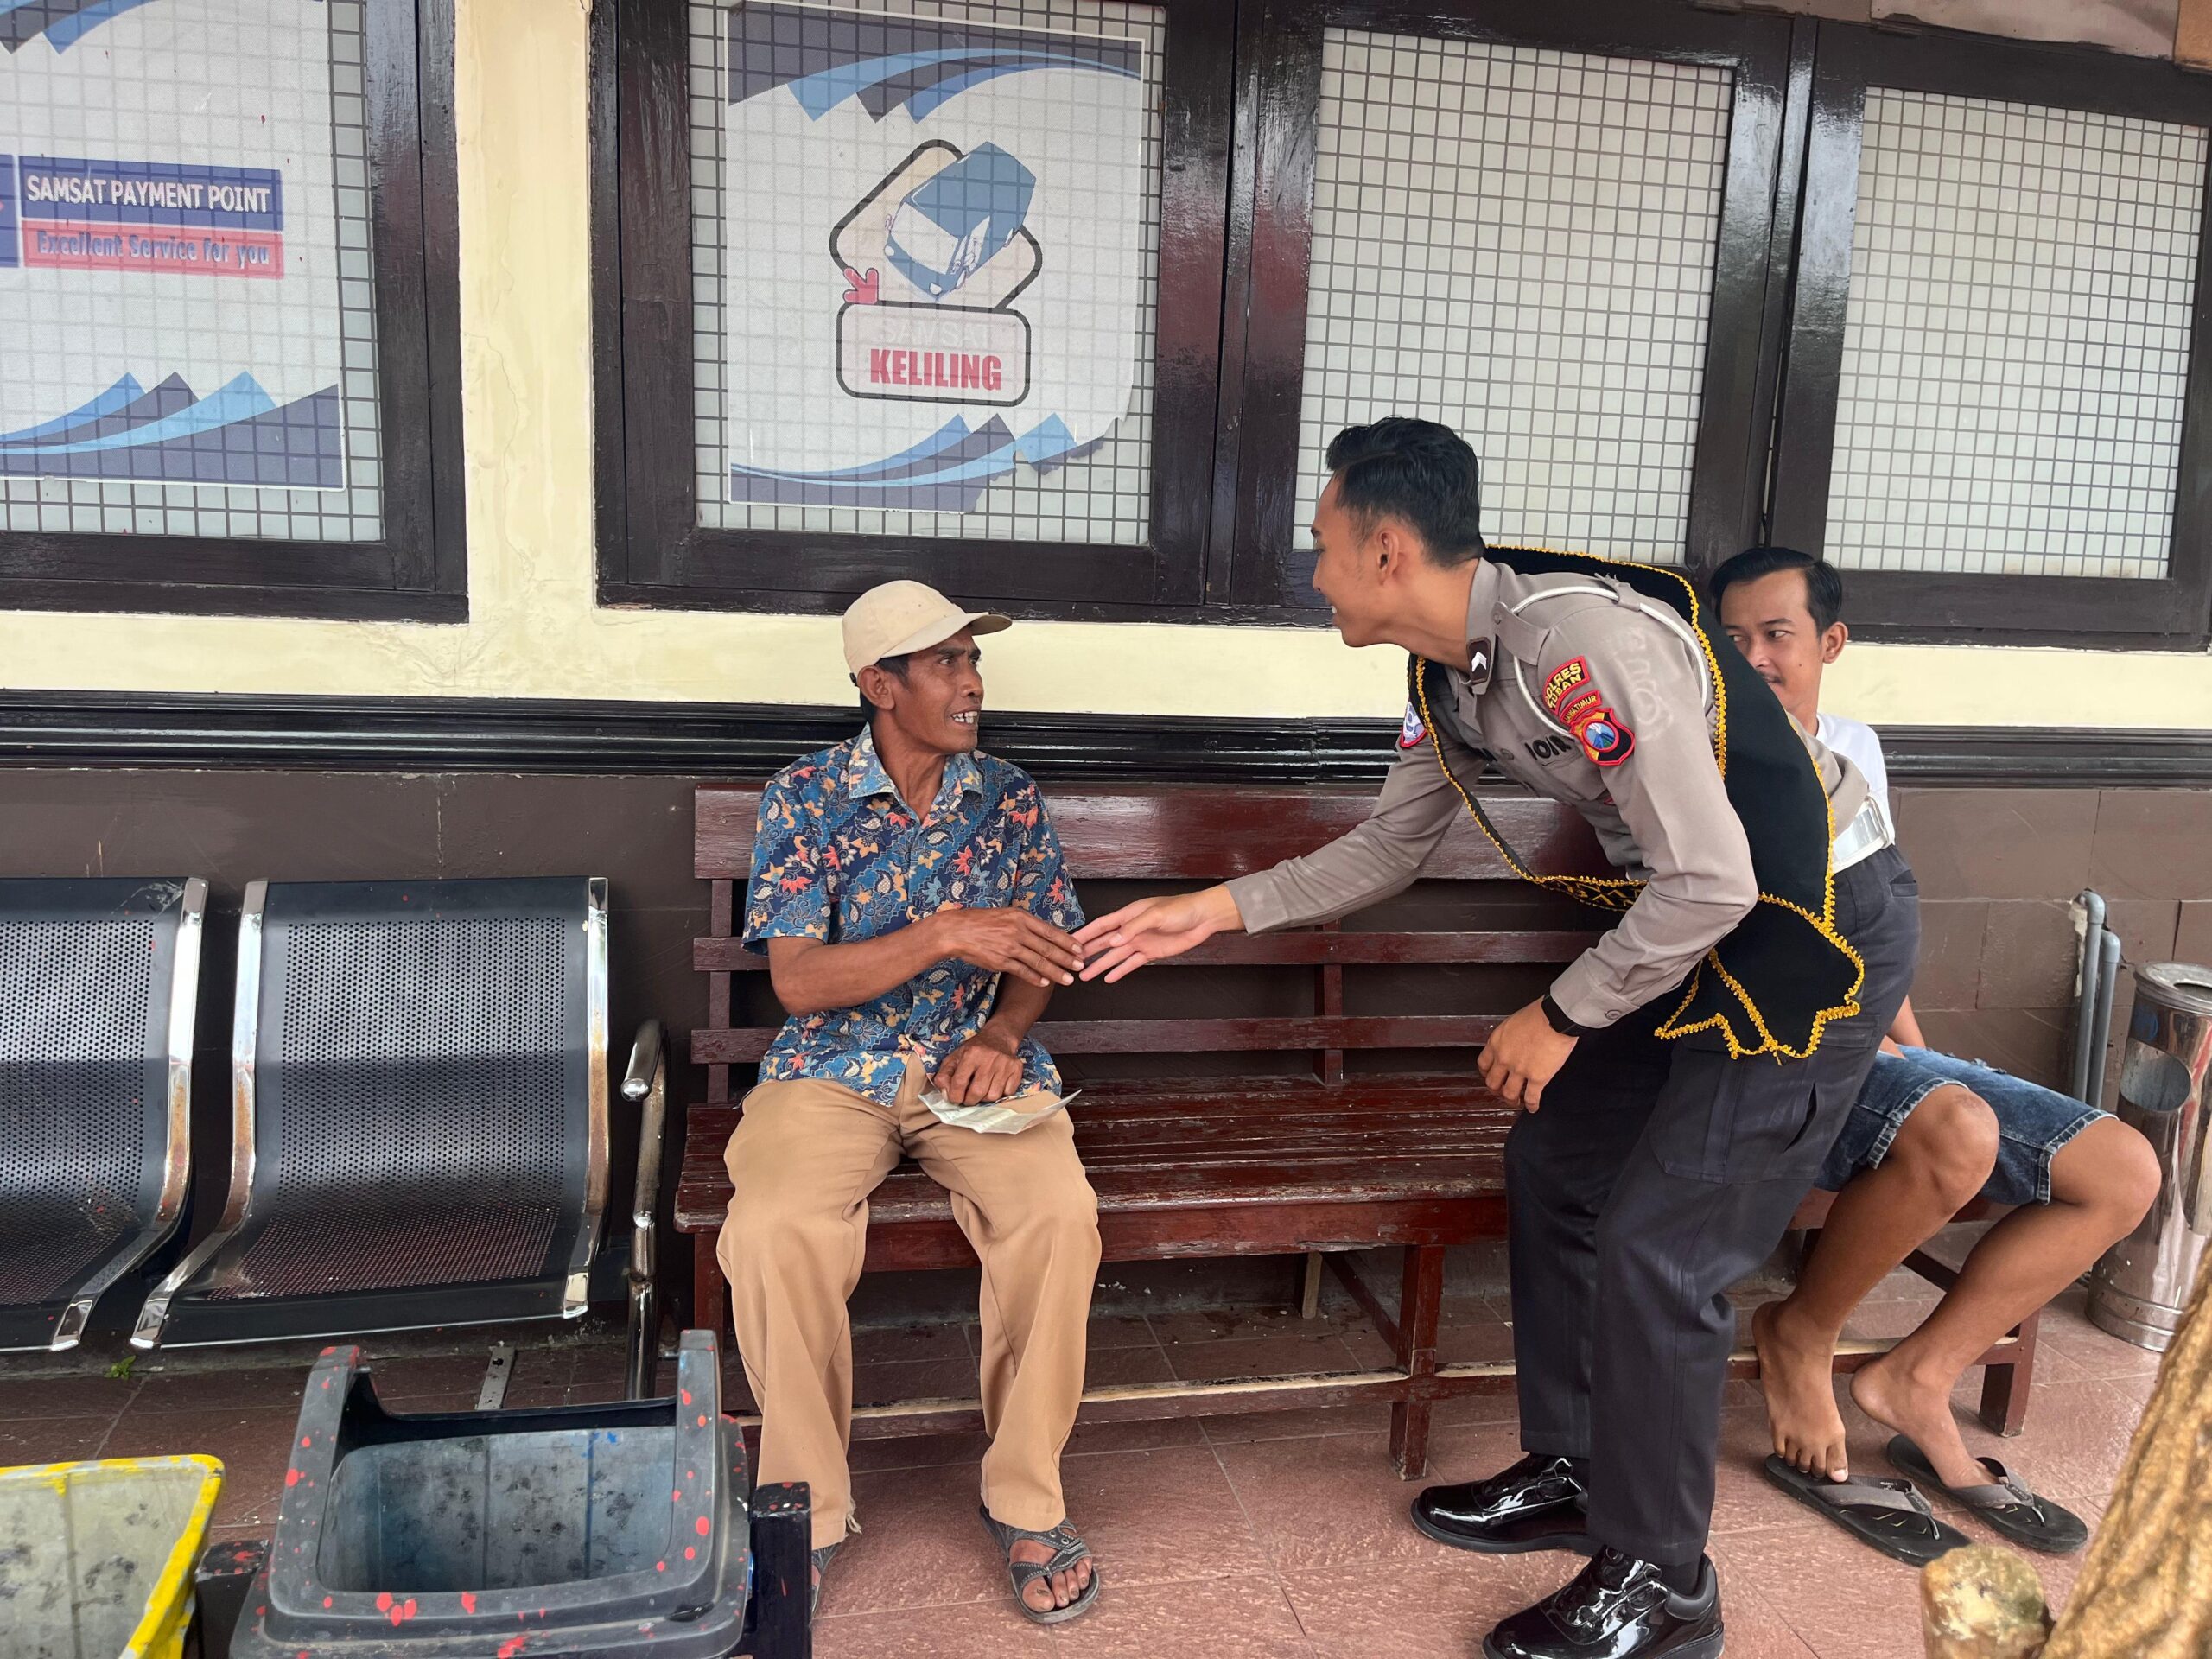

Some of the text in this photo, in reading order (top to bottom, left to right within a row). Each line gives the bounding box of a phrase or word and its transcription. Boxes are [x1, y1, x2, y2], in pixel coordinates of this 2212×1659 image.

[27, 175, 270, 213] SAMSAT PAYMENT POINT
[36, 230, 270, 270] Excellent Service for you
[870, 348, 1002, 391] KELILING
